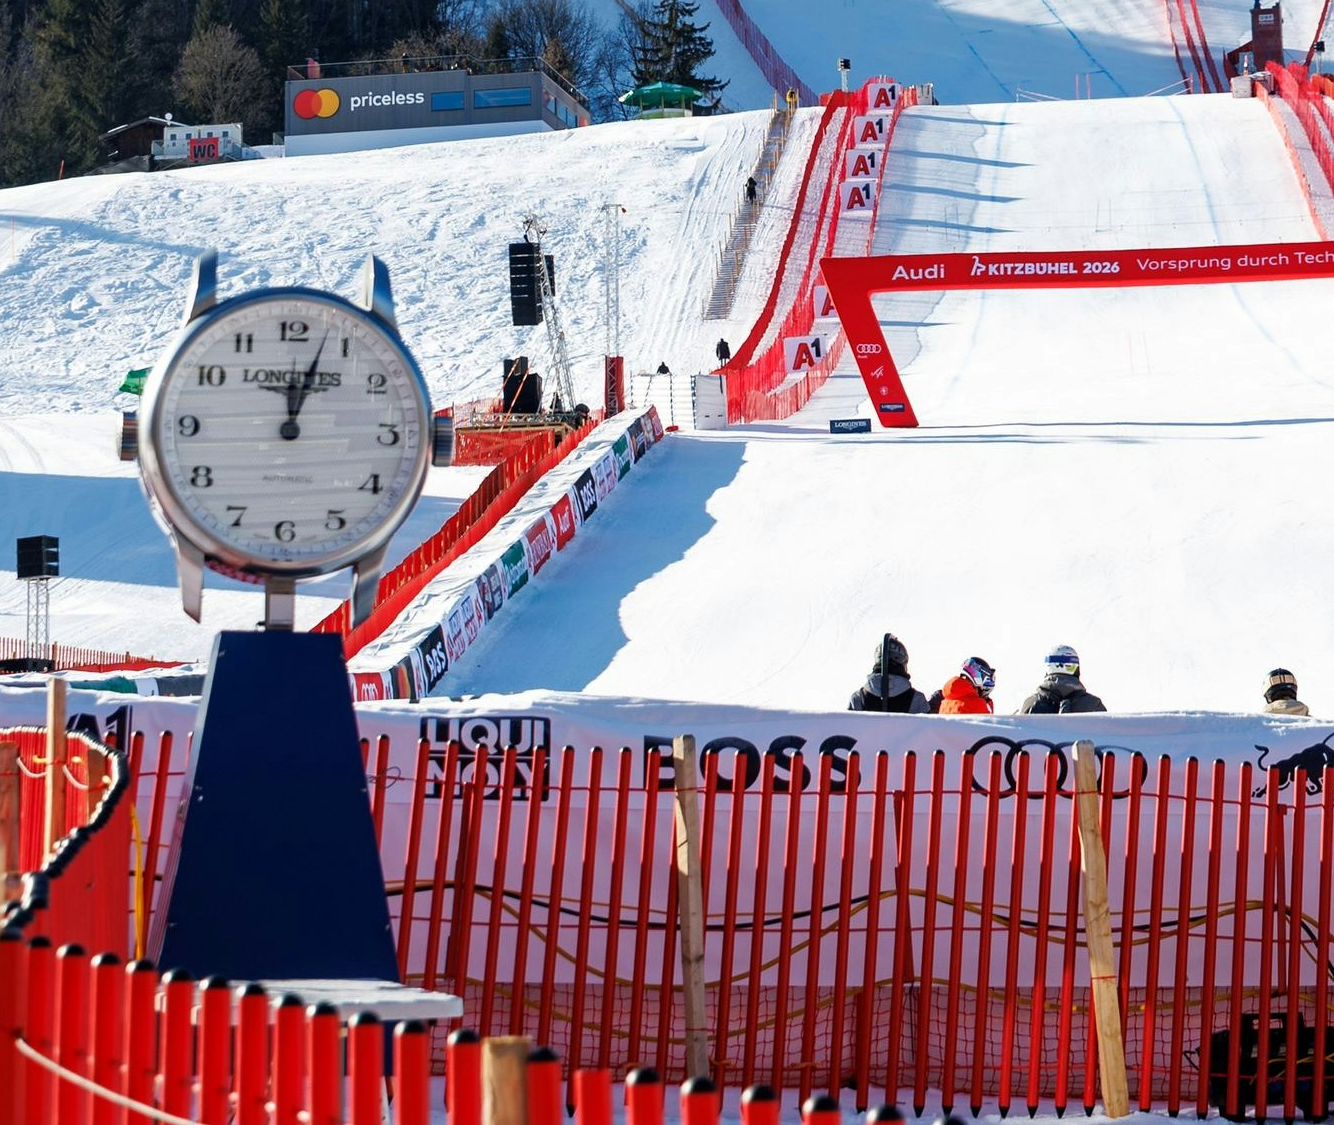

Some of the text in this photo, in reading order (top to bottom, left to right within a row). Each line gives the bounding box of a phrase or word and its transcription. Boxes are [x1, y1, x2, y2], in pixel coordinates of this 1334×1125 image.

[350, 91, 425, 111] priceless
[874, 85, 896, 108] A1
[860, 118, 883, 142] A1
[193, 144, 216, 159] WC
[851, 152, 875, 176] A1
[847, 183, 871, 209] A1
[891, 264, 945, 281] Audi
[1083, 261, 1120, 274] 2026
[1136, 256, 1232, 271] Vorsprung
[1237, 252, 1290, 267] durch
[233, 332, 254, 353] 11
[279, 321, 309, 342] 12
[340, 337, 350, 358] 1
[793, 337, 822, 371] A1
[197, 365, 226, 387] 10
[367, 373, 387, 395] 2
[178, 415, 201, 437] 9
[377, 423, 400, 447] 3
[190, 466, 214, 488] 8
[262, 474, 314, 484] AUTOMATIC
[357, 473, 383, 495] 4
[226, 505, 248, 527] 7
[324, 509, 347, 531] 5
[274, 520, 296, 543] 6
[425, 641, 447, 683] BOSS
[426, 718, 547, 756] LIQUI
